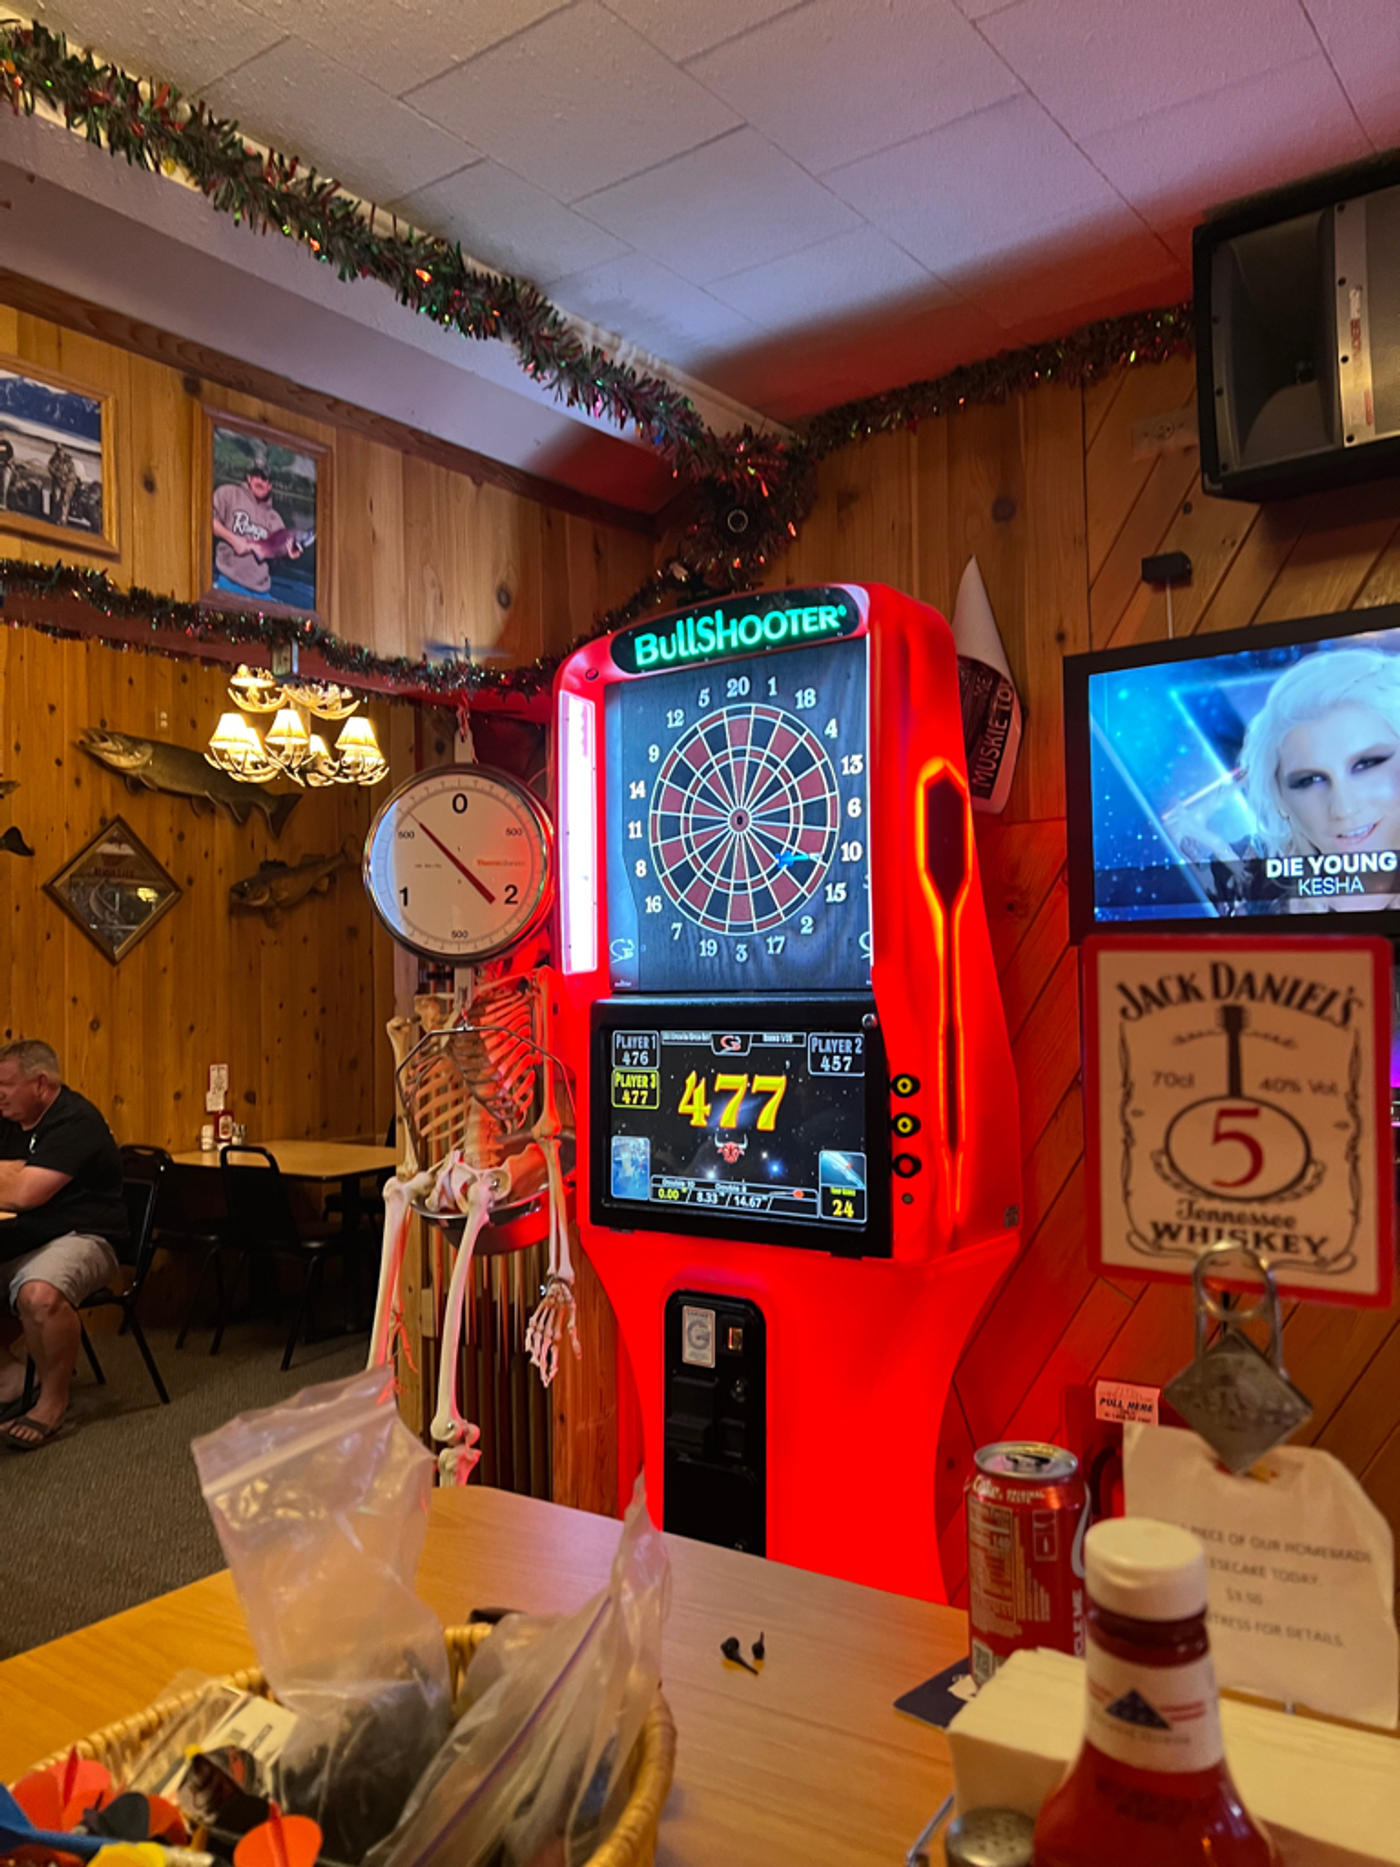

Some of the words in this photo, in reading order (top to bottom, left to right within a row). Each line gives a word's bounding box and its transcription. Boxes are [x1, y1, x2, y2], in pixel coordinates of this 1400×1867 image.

[727, 676, 750, 697] 20
[767, 676, 777, 696] 1
[698, 688, 710, 707] 5
[795, 688, 816, 709] 18
[666, 709, 685, 728] 12
[825, 718, 838, 738] 4
[648, 744, 660, 762] 9
[972, 719, 1009, 788] MUSKIE
[840, 754, 863, 775] 13
[629, 780, 646, 799] 14
[452, 793, 468, 814] 0
[847, 797, 861, 817] 6
[398, 831, 415, 840] 500
[505, 828, 523, 837] 500
[628, 820, 642, 838] 11
[841, 841, 862, 861] 10
[635, 860, 647, 877] 8
[1266, 857, 1305, 879] DIE
[1307, 850, 1398, 876] YOUNG
[504, 884, 518, 904] 2
[825, 883, 847, 902] 15
[1298, 875, 1364, 896] KESHA
[399, 886, 408, 907] 1
[645, 895, 662, 913] 16
[451, 930, 468, 938] 500
[671, 923, 683, 940] 7
[801, 915, 814, 934] 2
[699, 939, 718, 957] 19
[735, 944, 748, 962] 3
[766, 936, 785, 954] 17
[1116, 971, 1205, 1022] JACK
[615, 1033, 650, 1049] PLAYER
[651, 1034, 657, 1049] 1
[811, 1036, 853, 1054] PLAYER
[854, 1037, 862, 1054] 2
[621, 1050, 649, 1066] 476
[820, 1055, 852, 1072] 457
[614, 1071, 649, 1088] PLAYER
[621, 1089, 649, 1105] 477
[678, 1070, 787, 1132] 477
[1211, 1107, 1264, 1188] 5
[832, 1199, 854, 1218] 24
[1176, 1198, 1297, 1229] Tennessee
[1151, 1221, 1329, 1256] WHISKEY
[1208, 1556, 1266, 1579] ESECAKE
